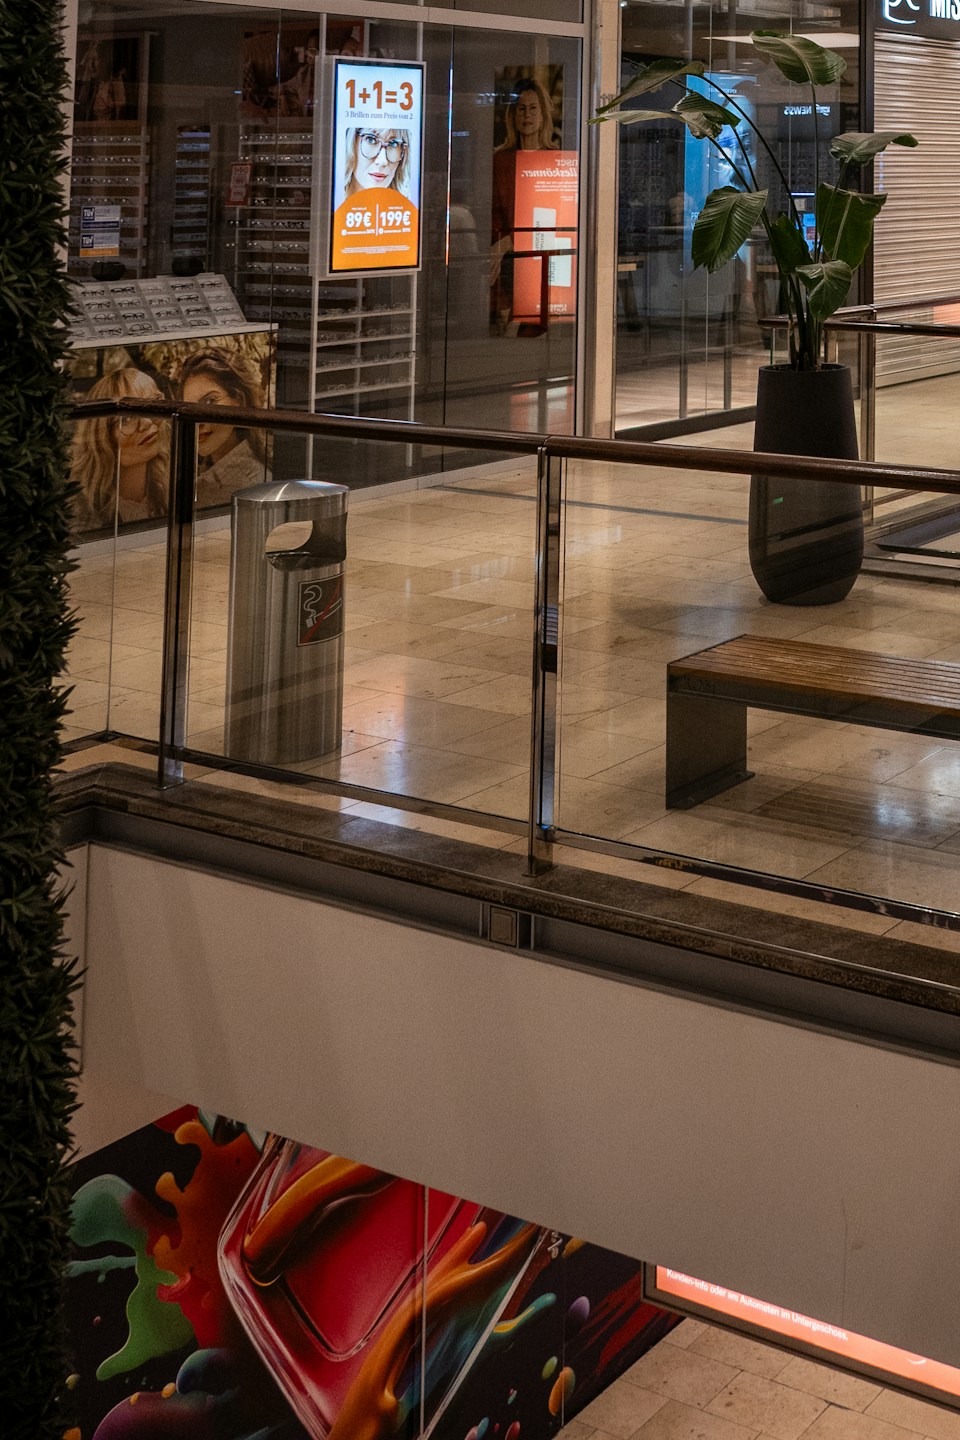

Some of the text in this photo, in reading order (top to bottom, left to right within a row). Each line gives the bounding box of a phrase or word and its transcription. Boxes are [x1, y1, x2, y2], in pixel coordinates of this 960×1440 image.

[345, 79, 413, 111] 1+1=3
[346, 211, 411, 228] 89€ 199€
[666, 1268, 849, 1341] Kunden-Info oder am Automaten im Untergeschoss.
